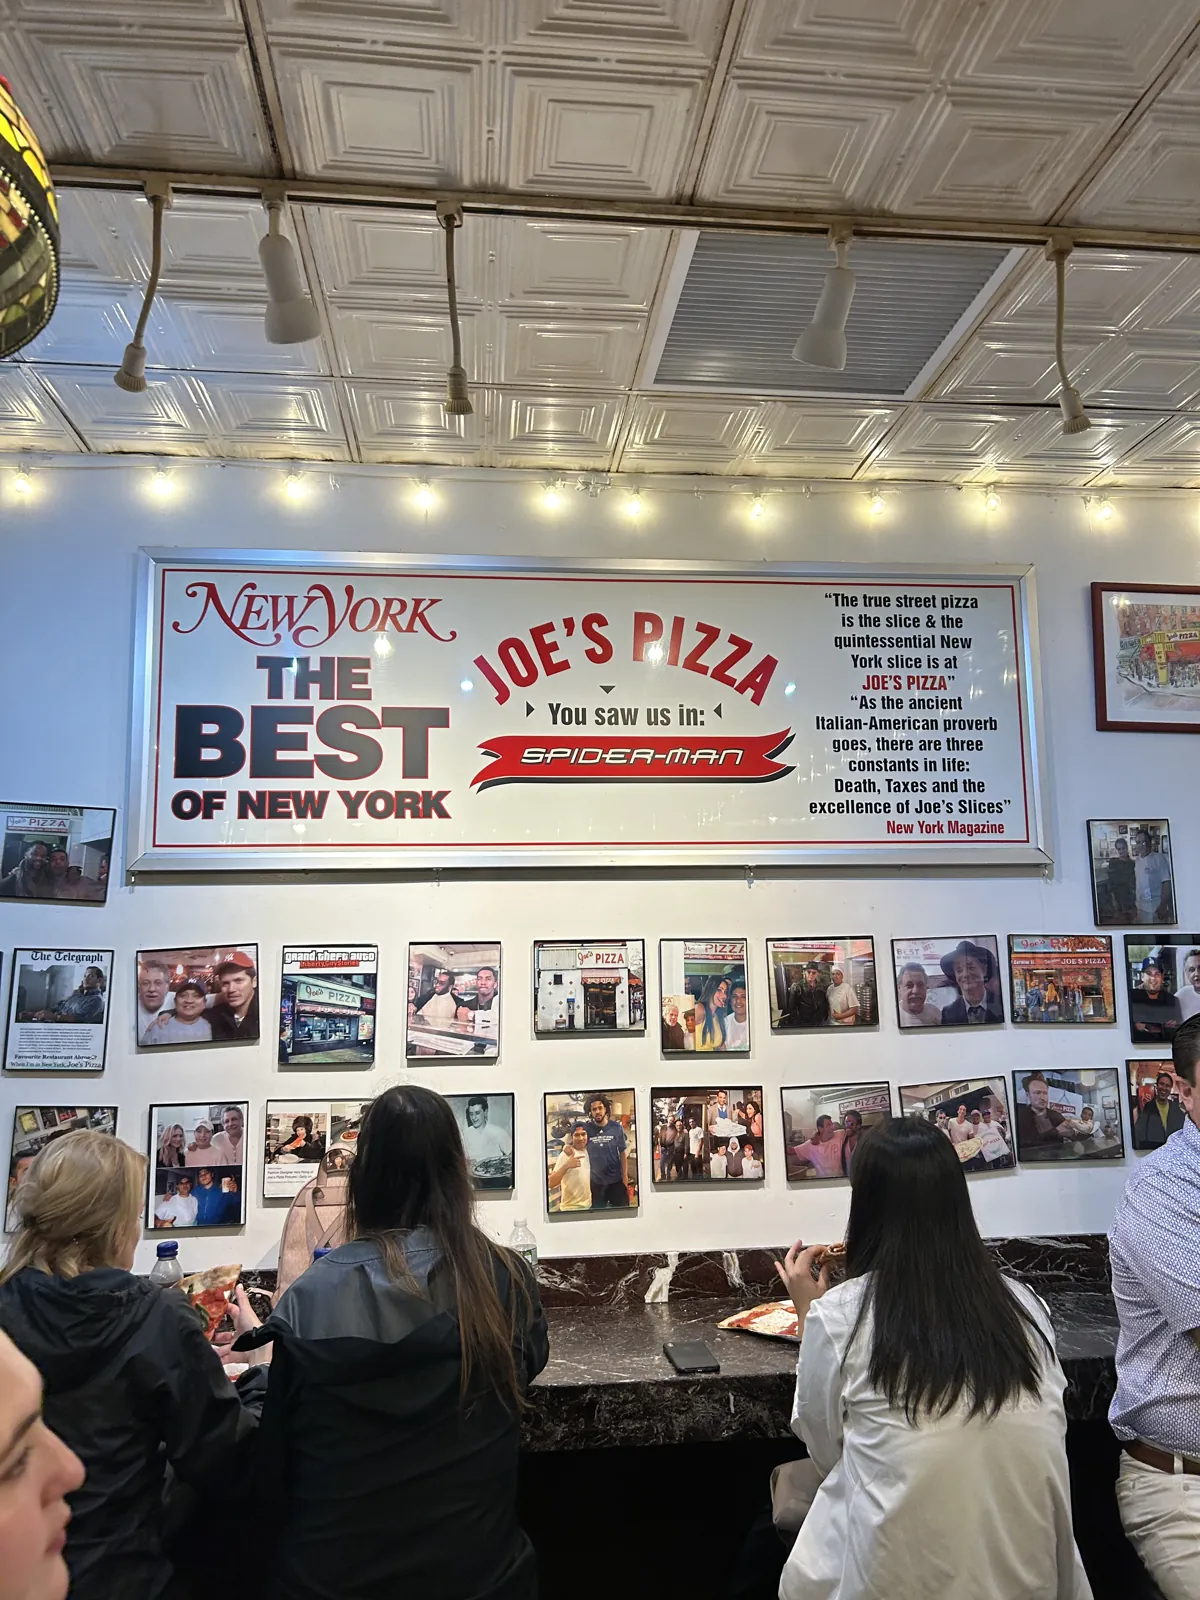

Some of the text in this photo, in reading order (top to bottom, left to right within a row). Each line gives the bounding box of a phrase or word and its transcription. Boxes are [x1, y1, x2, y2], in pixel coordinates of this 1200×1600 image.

[825, 593, 978, 610] "The true street pizza
[172, 581, 457, 648] NEW YORK
[841, 614, 963, 629] is the slice & the
[834, 634, 972, 650] quintessential New
[473, 611, 779, 707] JOE'S PIZZA
[851, 654, 958, 669] York slice is at
[256, 655, 373, 701] THE
[862, 675, 955, 691] JOE'S PIZZA"
[850, 695, 963, 711] "As the ancient
[548, 702, 705, 727] You saw us in:
[816, 716, 998, 732] Italian-American proverb
[174, 704, 450, 781] BEST
[832, 737, 984, 753] goes, there are three
[520, 747, 744, 765] SPIDER-MAN
[849, 758, 970, 772] constants in life:
[834, 778, 985, 794] Death, Taxes and the
[171, 789, 452, 820] OF NEW YORK
[809, 800, 891, 814] excellence
[896, 800, 910, 814] of
[915, 799, 953, 814] Joe's
[29, 818, 66, 828] PIZZA
[887, 821, 1004, 836] New York Magazine
[31, 950, 103, 964] The Telegraph
[350, 951, 375, 962] auto
[595, 953, 624, 964] PIZZA
[328, 991, 357, 1004] PIZZA
[66, 1060, 84, 1068] Joe's
[855, 1096, 887, 1107] PIZZA
